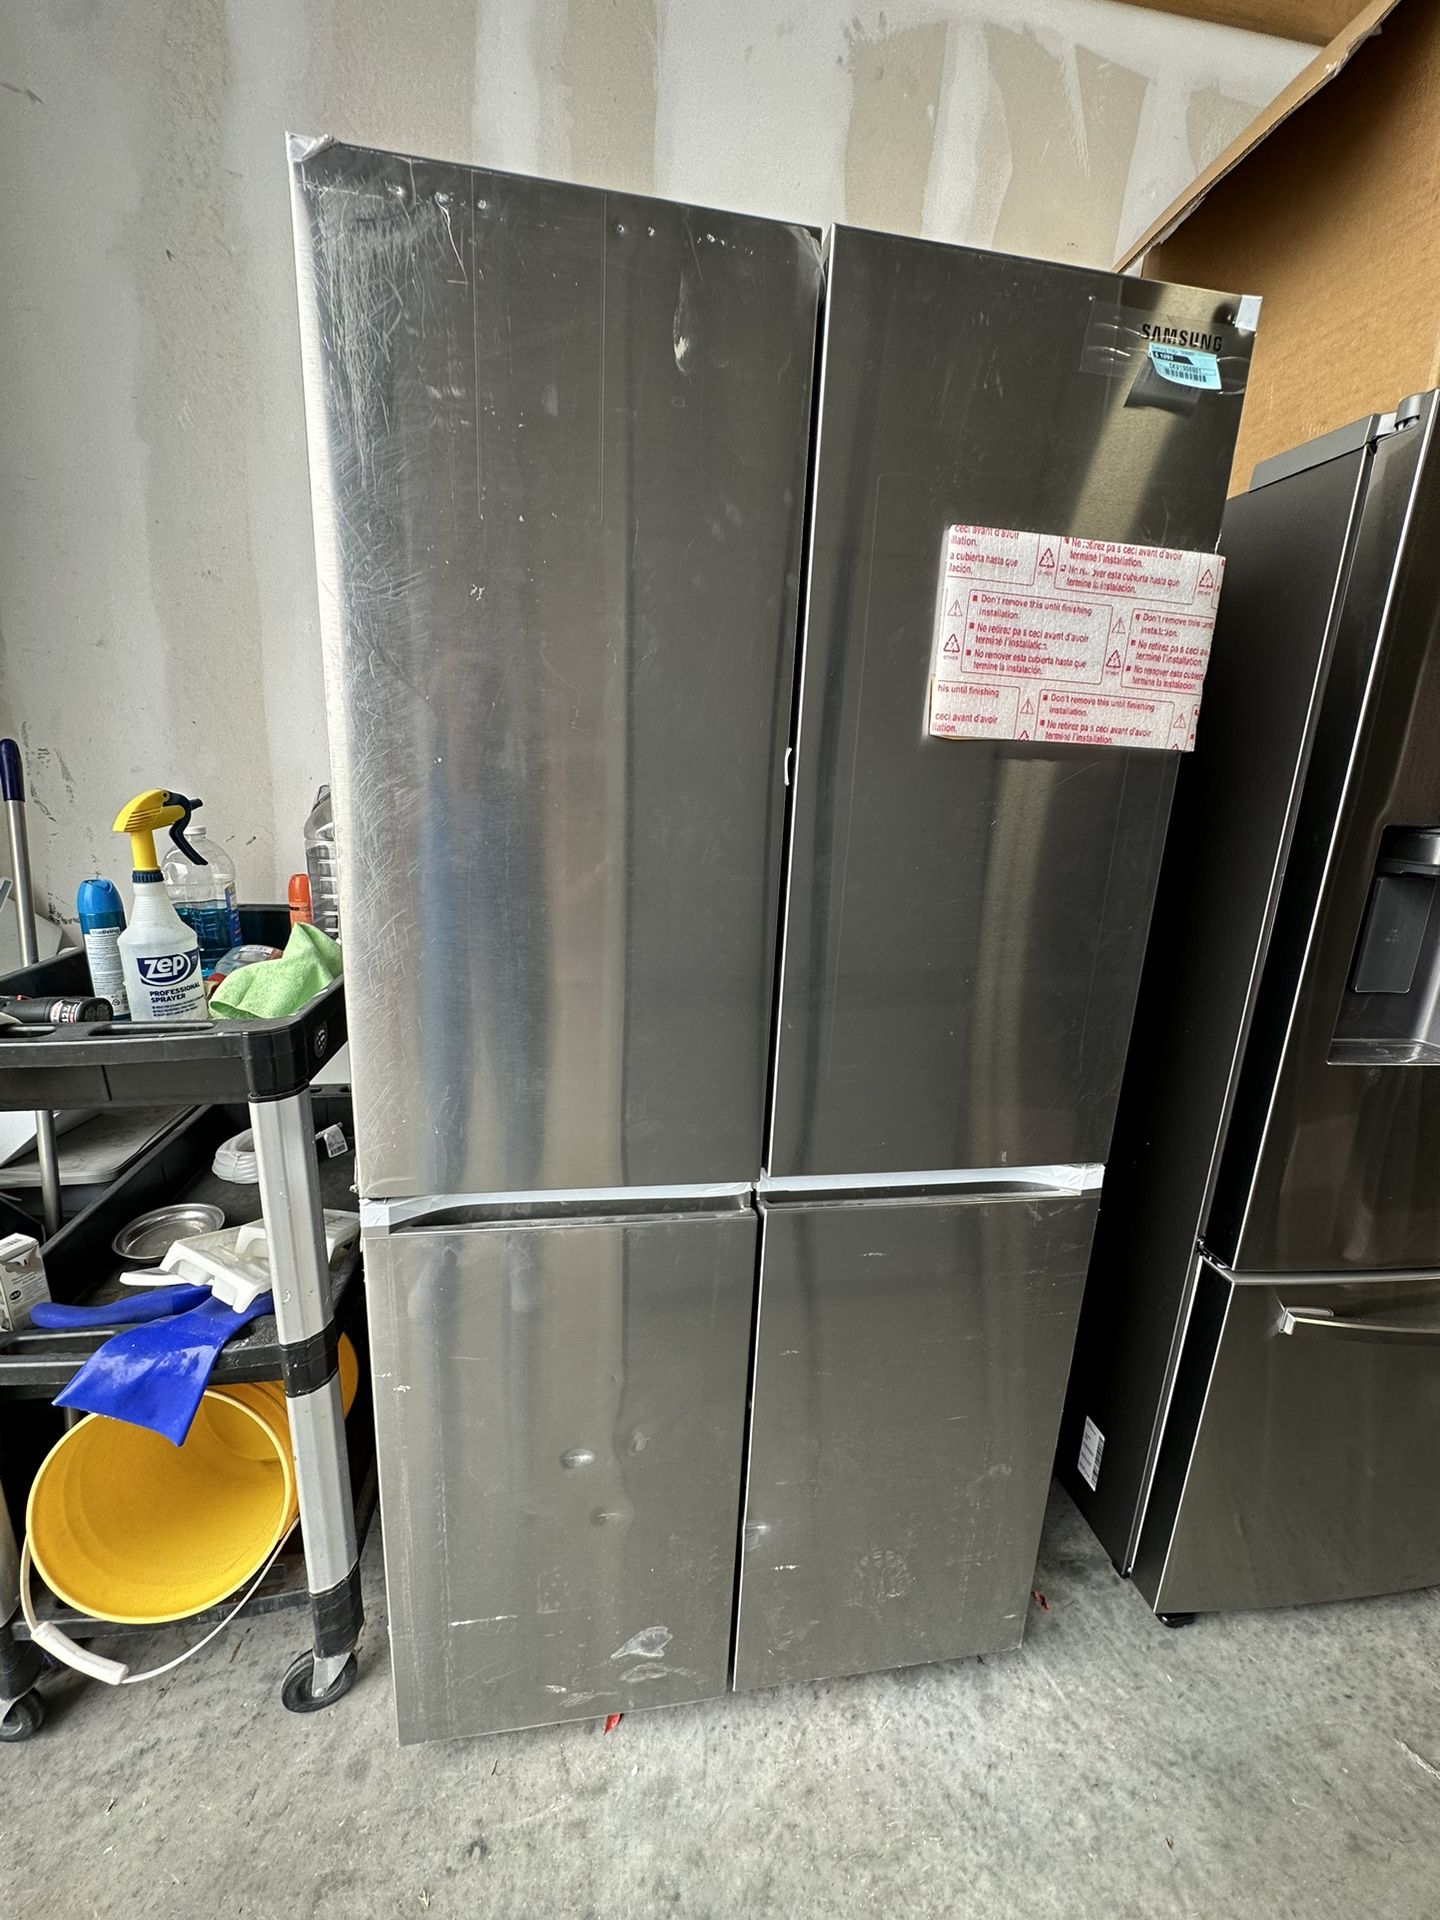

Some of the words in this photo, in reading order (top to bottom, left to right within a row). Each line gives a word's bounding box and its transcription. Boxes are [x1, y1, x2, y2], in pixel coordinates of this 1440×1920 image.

[1142, 323, 1223, 352] SAMSUNG
[994, 527, 1020, 540] davoir
[956, 550, 985, 564] cubierta
[986, 553, 1004, 566] hasta
[1004, 558, 1018, 568] que
[981, 594, 1000, 604] Don't
[1002, 598, 1028, 608] remove
[1030, 600, 1043, 609] this
[1044, 602, 1060, 611] until
[1062, 603, 1092, 617] finishing
[979, 608, 1020, 619] installation.
[1142, 613, 1162, 623] Don't
[1162, 616, 1186, 626] remove
[977, 622, 988, 632] Ne
[1028, 628, 1043, 639] ceci
[1044, 630, 1064, 640] avant
[1138, 640, 1148, 650] Ne
[1148, 641, 1168, 652] retirez
[974, 649, 984, 658] No
[984, 651, 1011, 662] remover
[1012, 654, 1026, 663] esta
[1028, 654, 1054, 666] cubierta
[1055, 657, 1073, 668] hasta
[1074, 660, 1086, 670] que
[999, 663, 1006, 672] la
[1134, 665, 1143, 674] No
[1144, 667, 1169, 677] remover
[1170, 669, 1182, 678] esta
[951, 685, 968, 694] until
[968, 686, 1000, 698] finishing
[1050, 693, 1070, 702] Don't
[1070, 696, 1096, 706] remove
[1097, 698, 1110, 706] this
[1110, 700, 1126, 708] until
[1126, 701, 1155, 712] finishing
[1049, 706, 1088, 716] installation.
[936, 712, 950, 721] ceci
[952, 714, 972, 722] avant
[974, 714, 998, 724] d'avoir
[1046, 720, 1057, 729] Ne
[1096, 724, 1109, 734] ceci
[1110, 726, 1128, 735] avant
[1130, 728, 1152, 737] d'avoir
[150, 982, 201, 998] PROFESSIONAL
[150, 993, 186, 1004] SPRAYER
